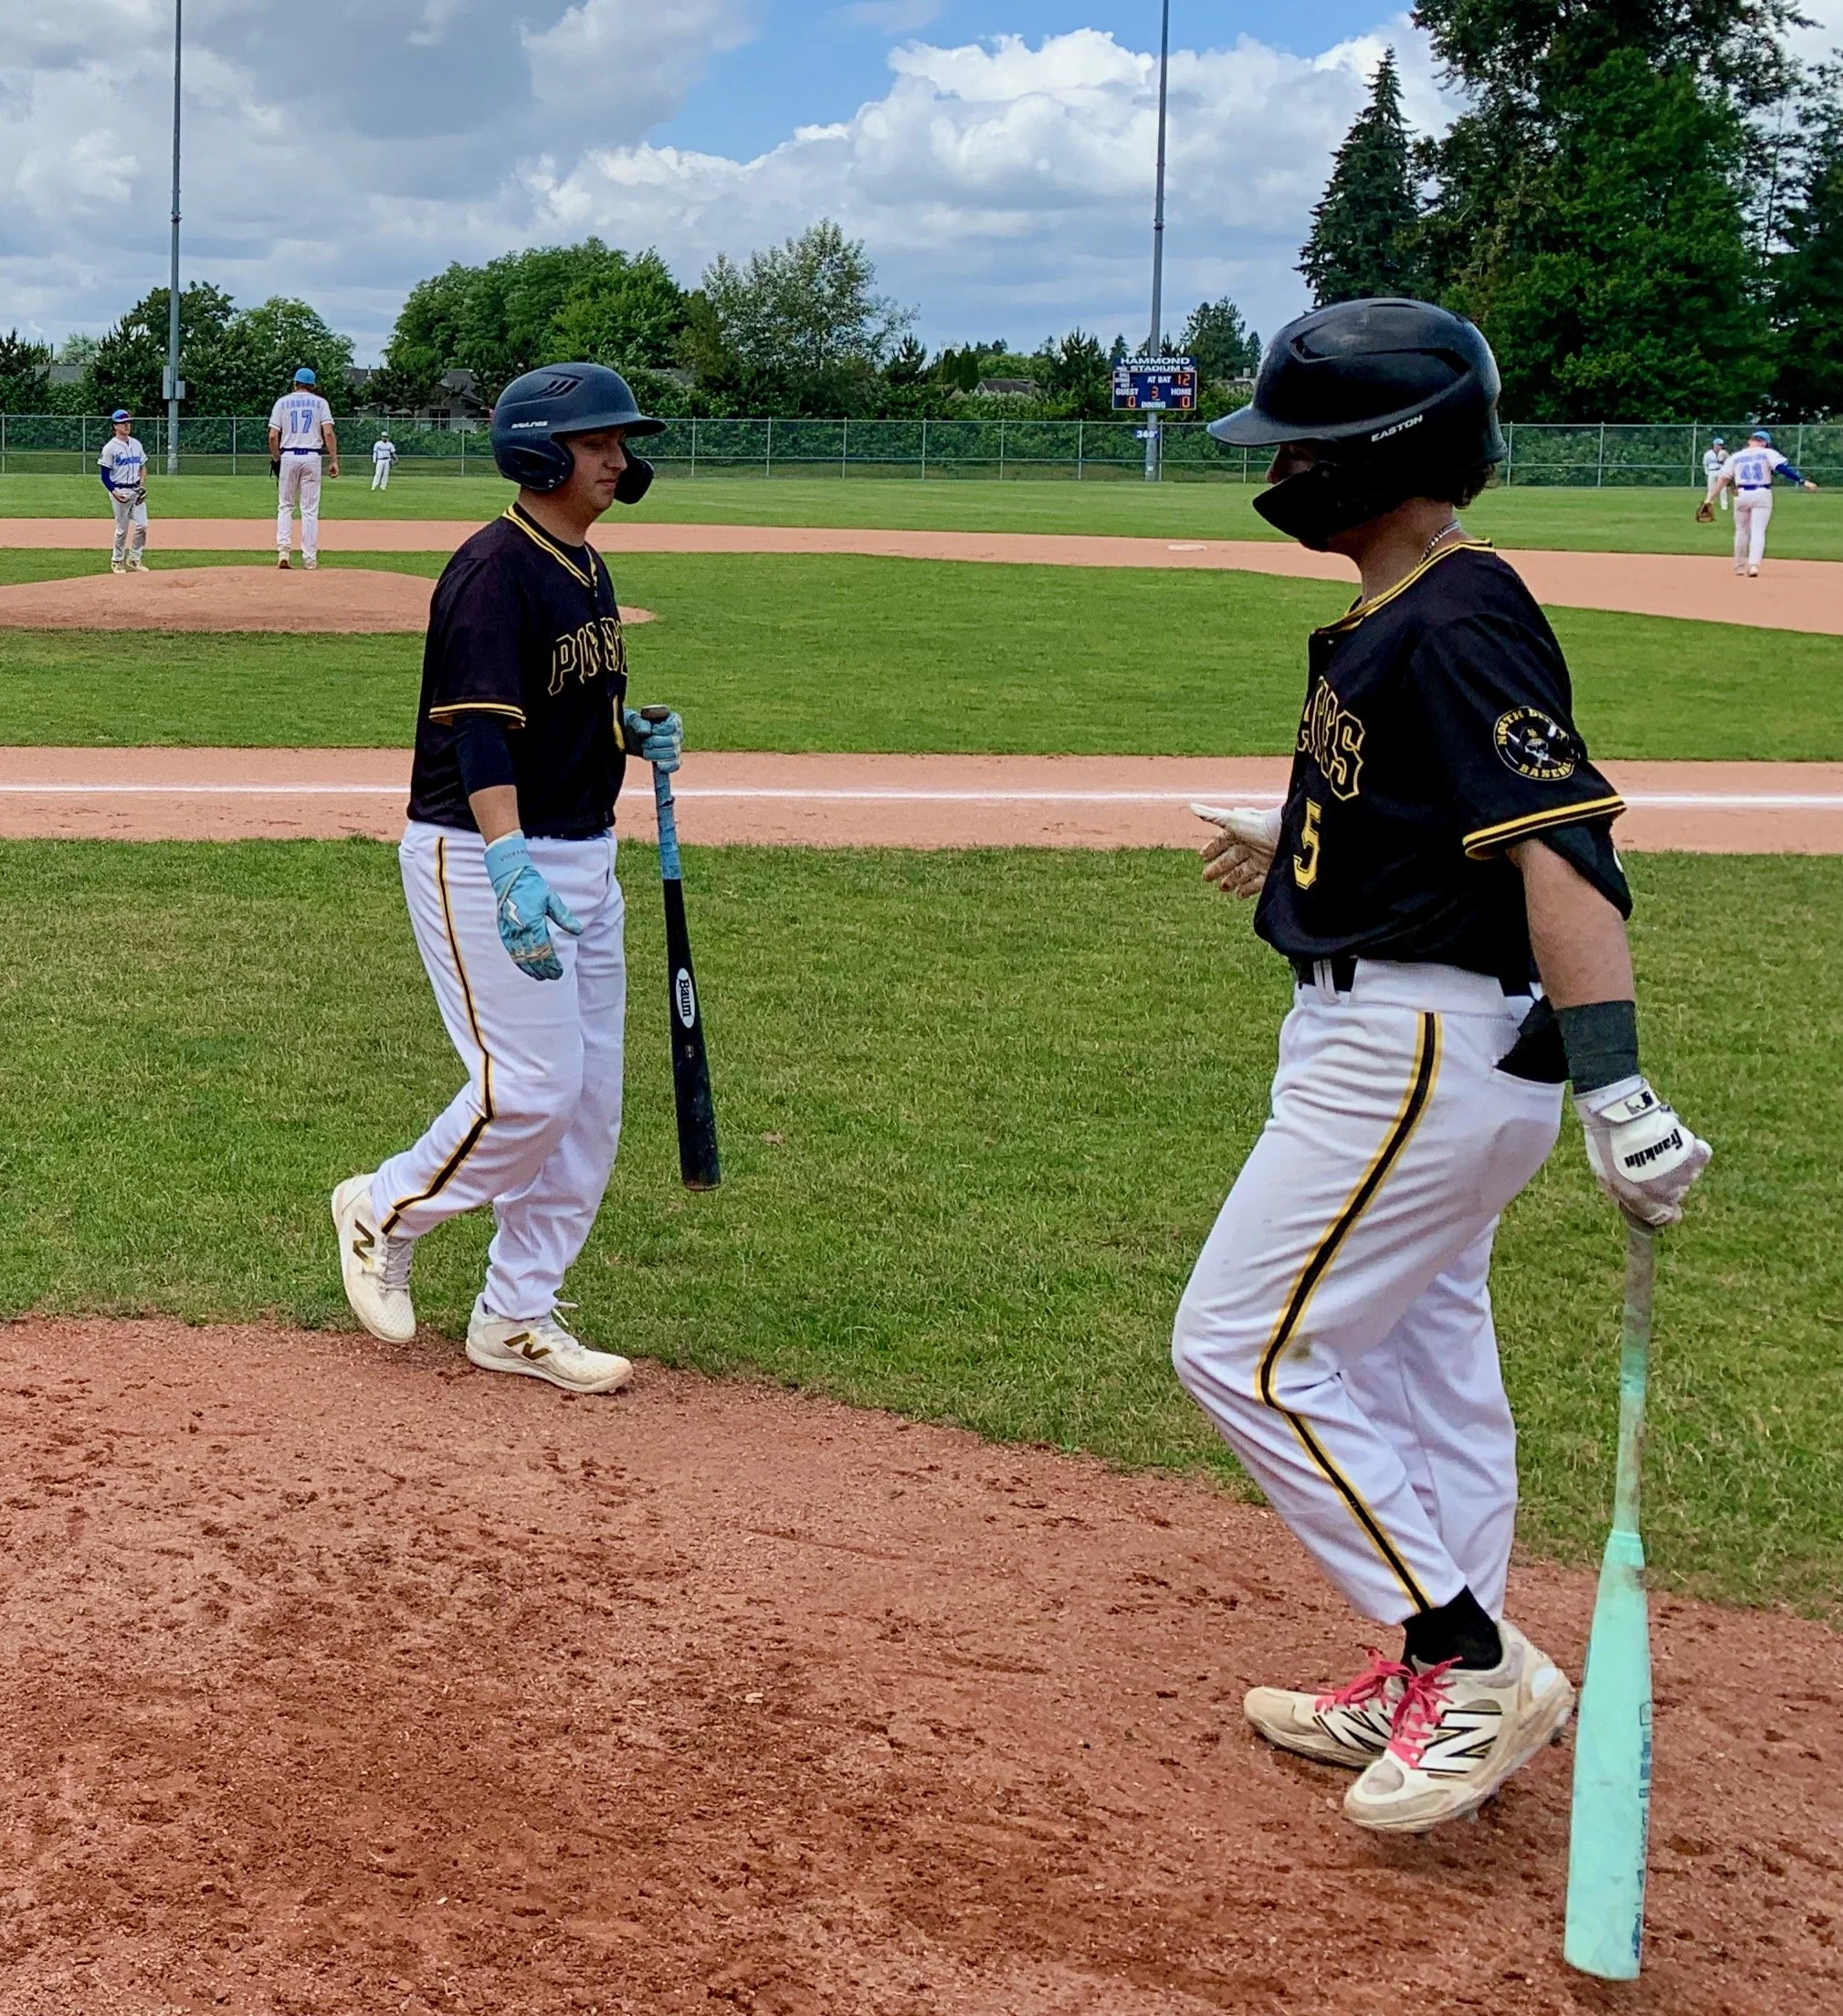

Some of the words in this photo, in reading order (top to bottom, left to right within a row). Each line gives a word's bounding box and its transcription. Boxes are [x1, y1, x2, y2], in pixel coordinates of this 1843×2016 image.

[1177, 374, 1191, 385] 12
[1128, 396, 1136, 408] 0
[1182, 396, 1191, 408] 0
[290, 409, 312, 434] 17
[1371, 414, 1423, 442] EASTON
[1497, 710, 1525, 745] NORTH
[1519, 762, 1573, 779] BASEB
[1293, 797, 1322, 890] 5
[679, 979, 692, 1018] Baum
[1624, 1128, 1684, 1168] franklin
